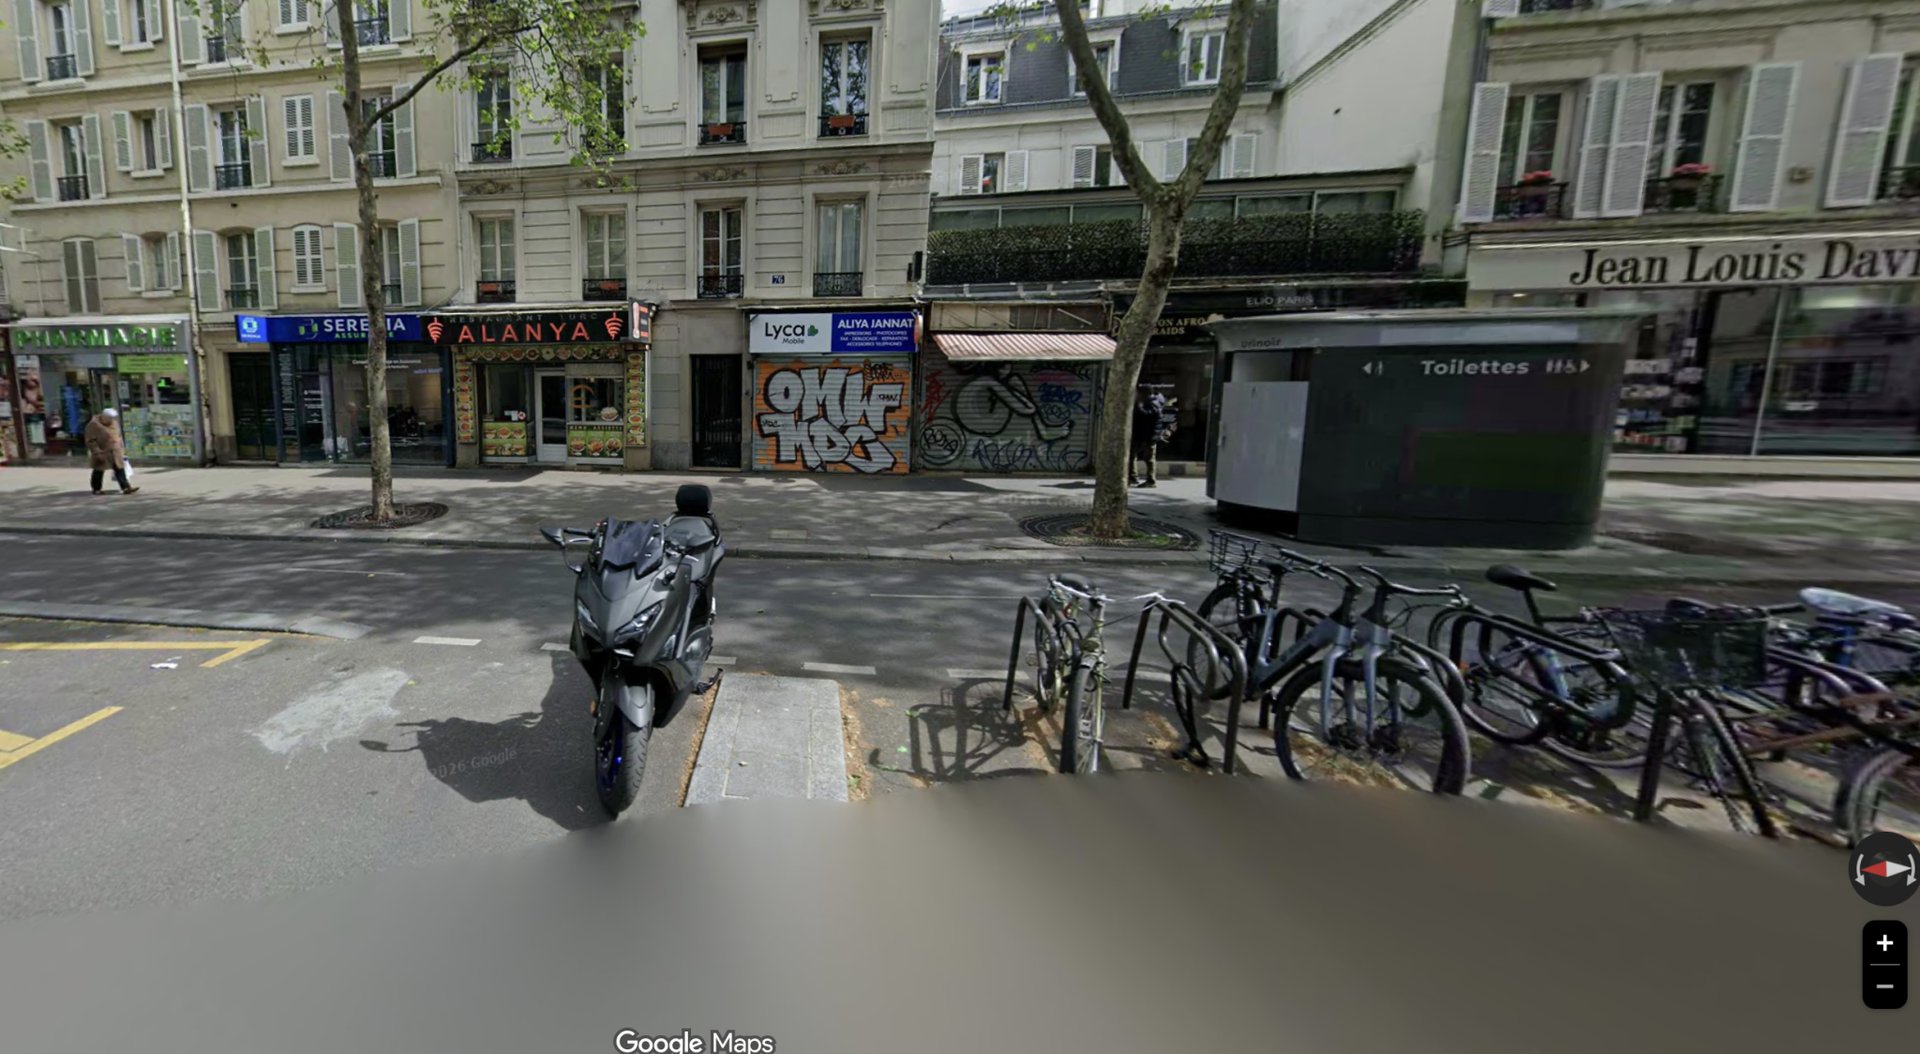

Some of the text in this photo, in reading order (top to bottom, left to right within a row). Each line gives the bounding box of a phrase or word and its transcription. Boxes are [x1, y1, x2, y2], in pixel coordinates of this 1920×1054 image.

[1570, 248, 1668, 286] Jean
[1681, 243, 1806, 283] Louis
[773, 275, 784, 284] 76
[1277, 294, 1313, 305] PARIS
[324, 318, 406, 332] SEREIA
[765, 322, 805, 339] Lyca
[838, 318, 914, 329] ALIYA JANNAT
[15, 327, 177, 348] PHARMACIE
[458, 322, 590, 343] ALANYA
[1240, 336, 1281, 349] Urinoir
[1420, 359, 1529, 376] Toilettes
